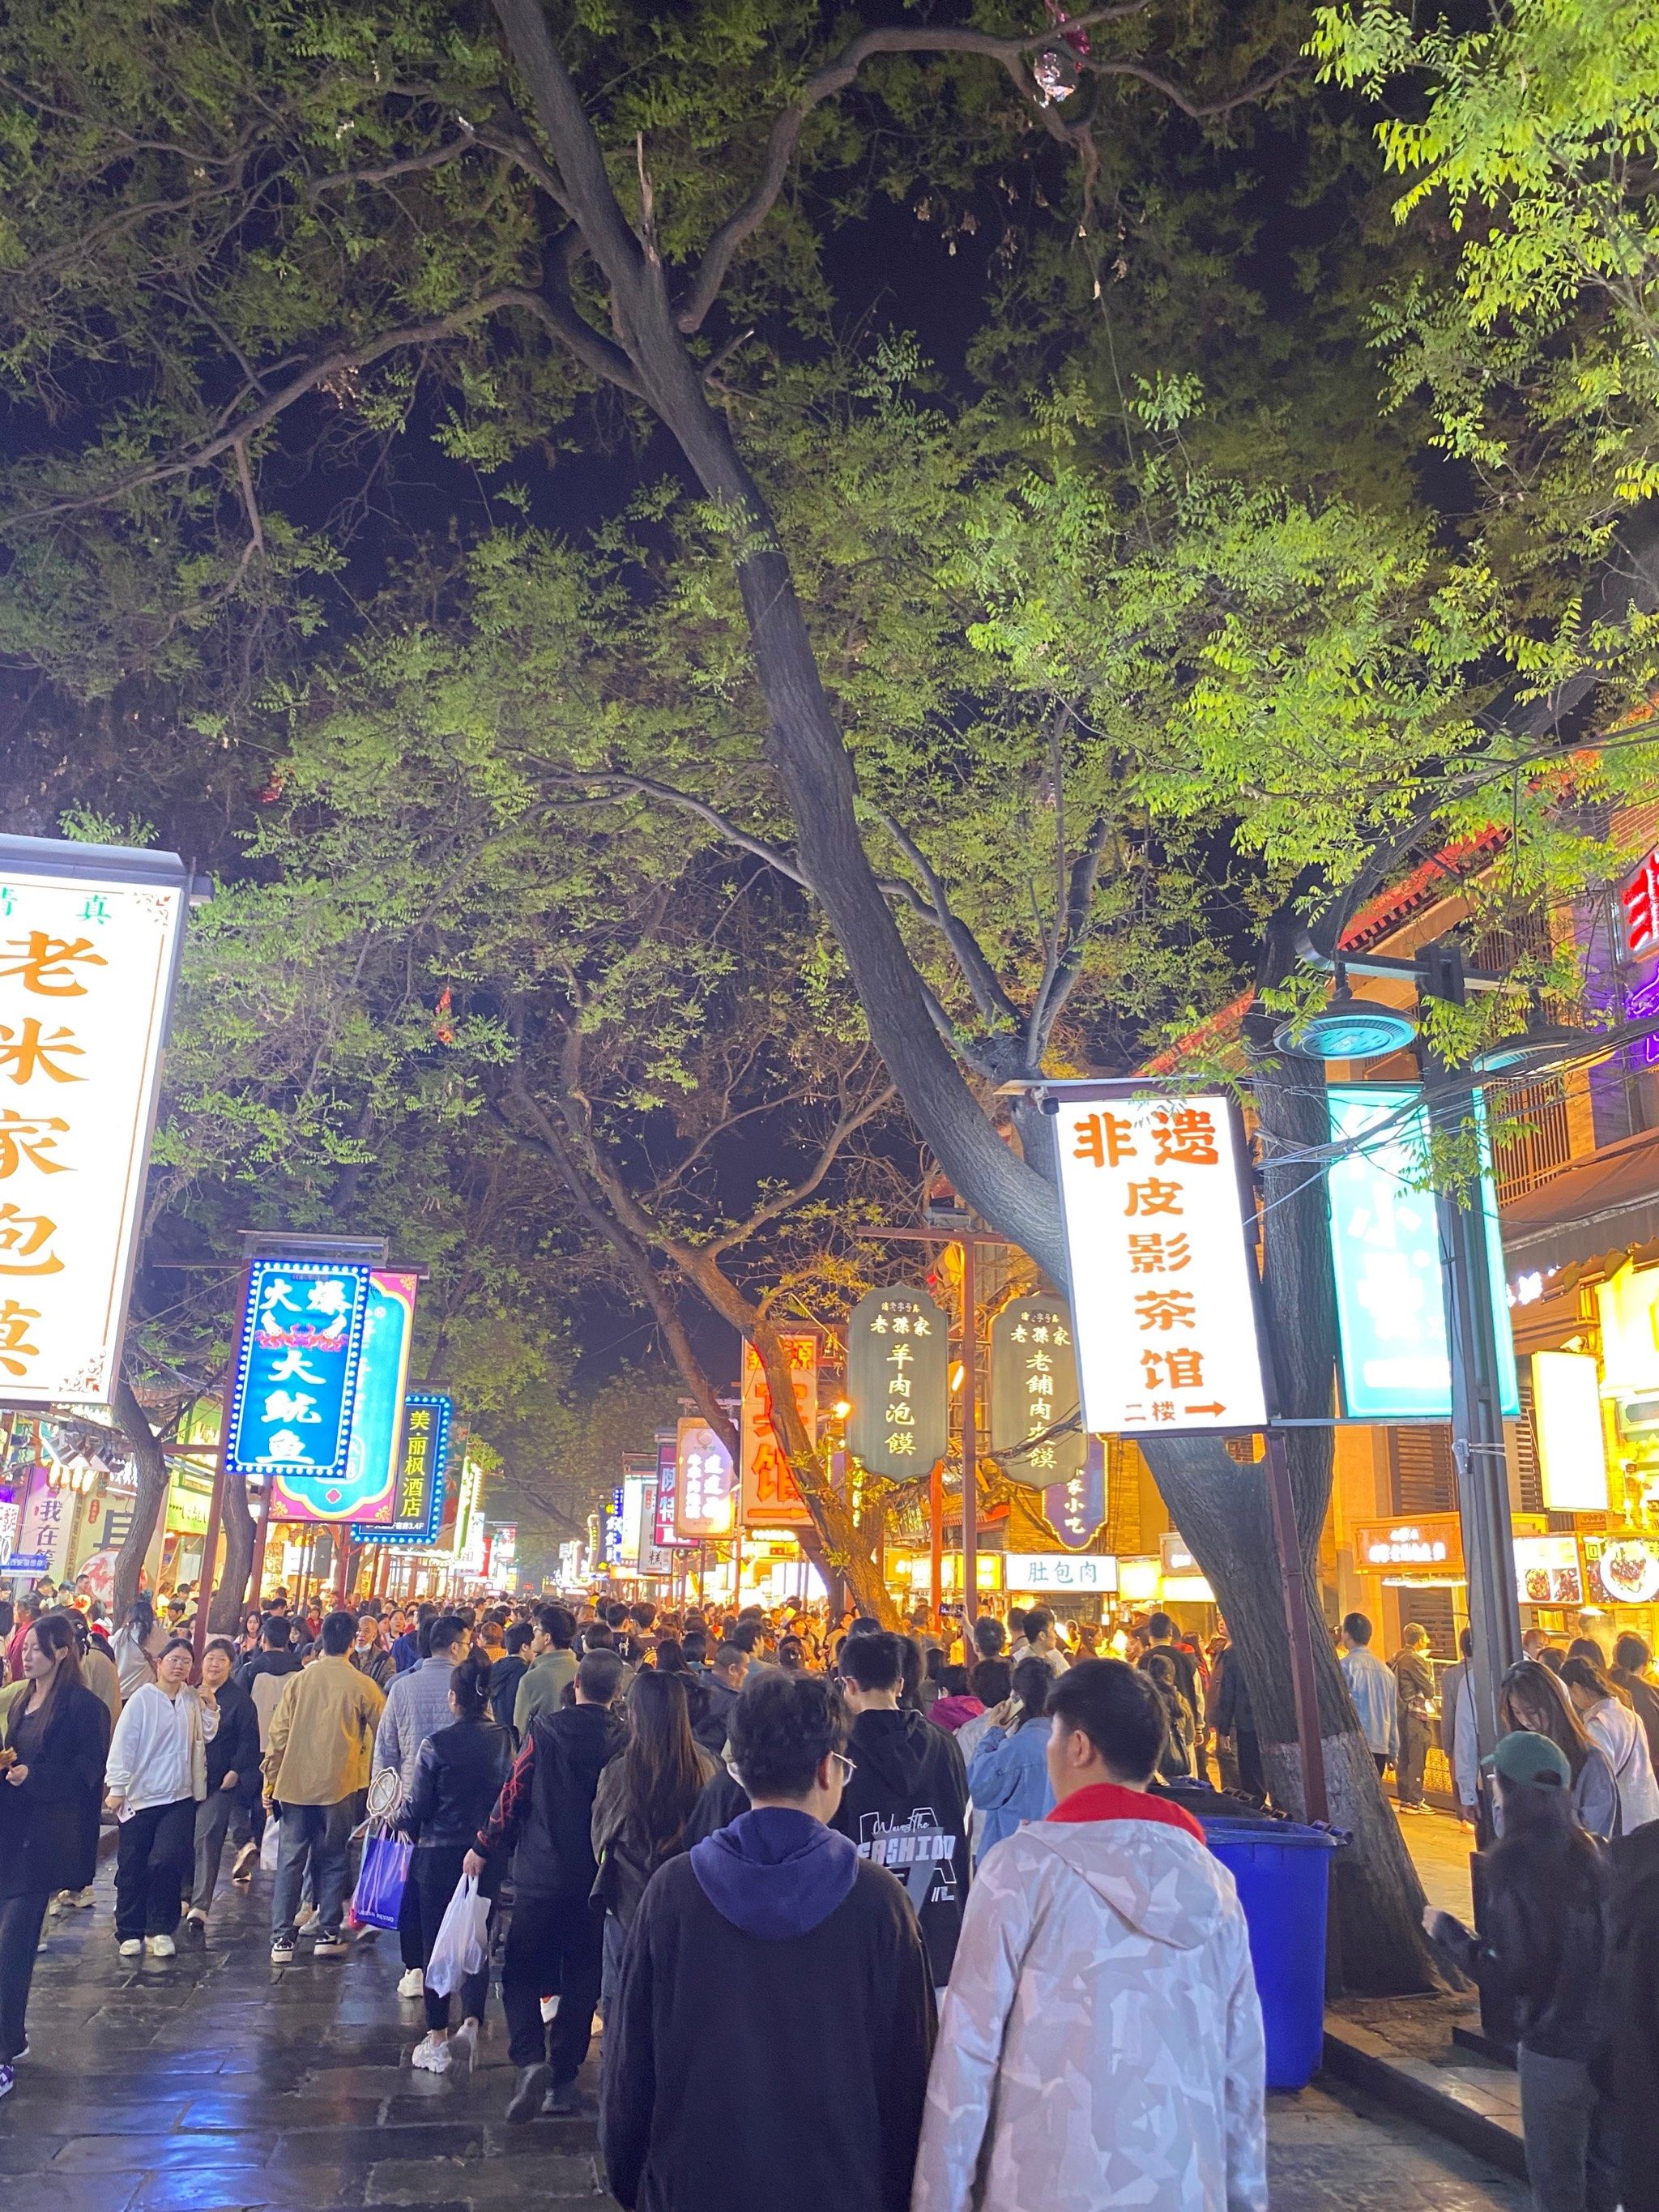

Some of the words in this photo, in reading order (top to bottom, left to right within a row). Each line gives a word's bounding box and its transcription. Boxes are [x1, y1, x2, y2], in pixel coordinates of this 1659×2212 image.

[1073, 1108, 1218, 1168] 非遗
[259, 1278, 352, 1316] 火爆
[1124, 1176, 1205, 1390] 皮影茶馆
[255, 1350, 326, 1464] 大鱿鱼
[1124, 1401, 1175, 1422] 二楼
[1064, 1468, 1085, 1534] 家小吃
[1028, 1561, 1098, 1583] 肚包肉
